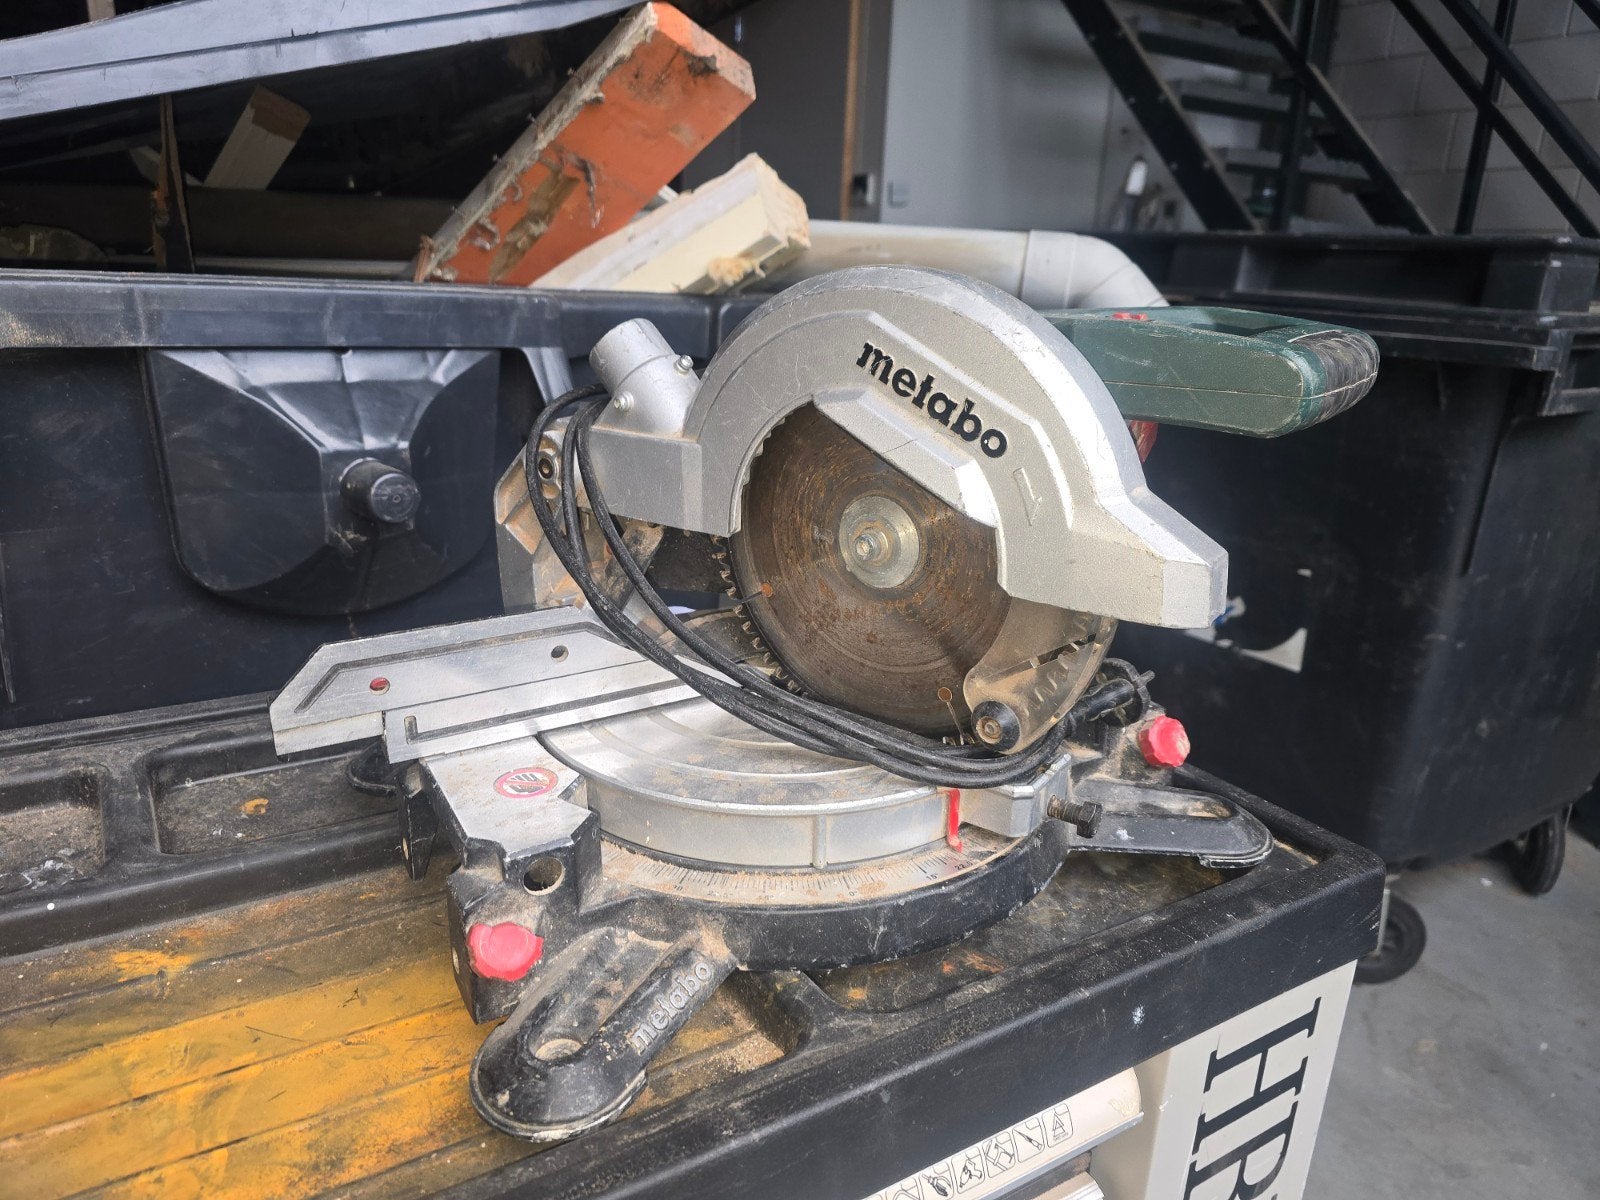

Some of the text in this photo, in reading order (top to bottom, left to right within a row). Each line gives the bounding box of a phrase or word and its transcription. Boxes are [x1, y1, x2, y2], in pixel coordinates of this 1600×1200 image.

[856, 342, 1008, 459] metabo
[627, 961, 712, 1056] metabo
[1182, 996, 1322, 1200] HR
